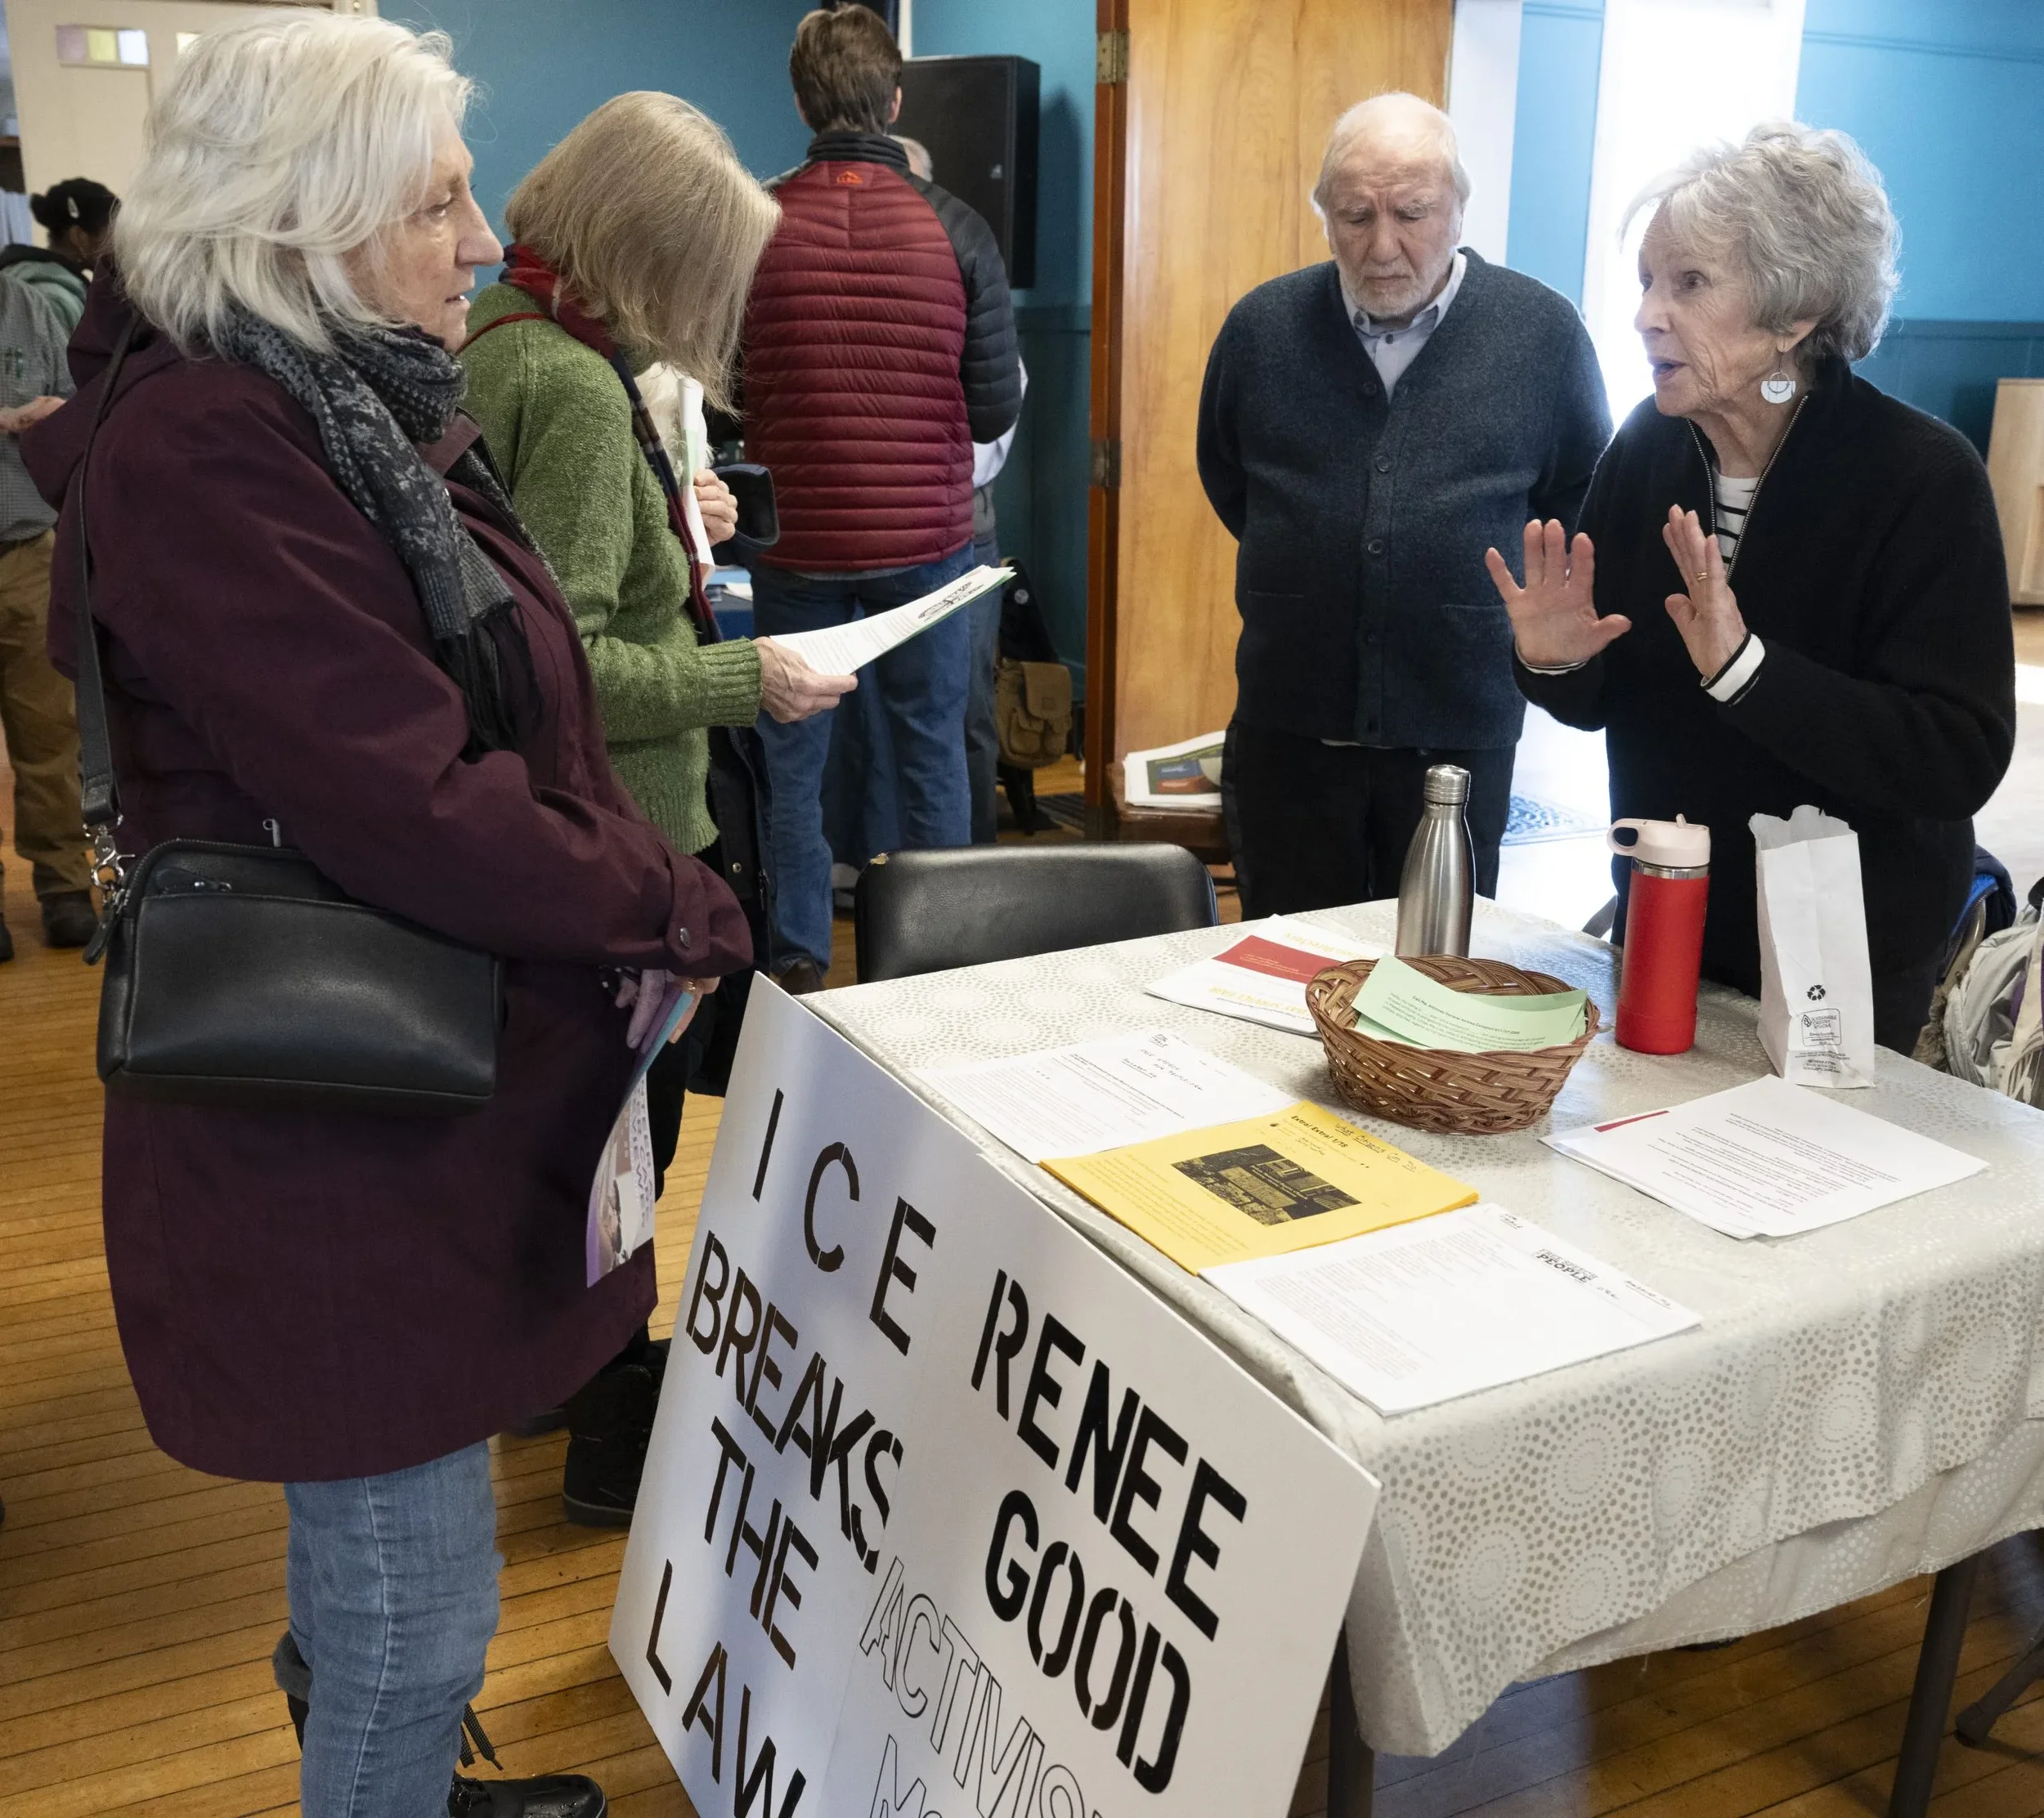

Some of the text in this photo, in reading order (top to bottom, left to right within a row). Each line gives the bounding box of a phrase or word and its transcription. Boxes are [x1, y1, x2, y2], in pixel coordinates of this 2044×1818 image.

[753, 1088, 936, 1356] ICE
[1291, 1115, 1313, 1128] Extra!
[1311, 1126, 1334, 1140] Extra!
[1535, 1253, 1592, 1283] PEOPLE
[686, 1231, 904, 1574] BREAKS
[970, 1269, 1248, 1642] RENEE
[704, 1416, 818, 1671] THE
[984, 1490, 1191, 1794] GOOD
[646, 1558, 806, 1818] LAW
